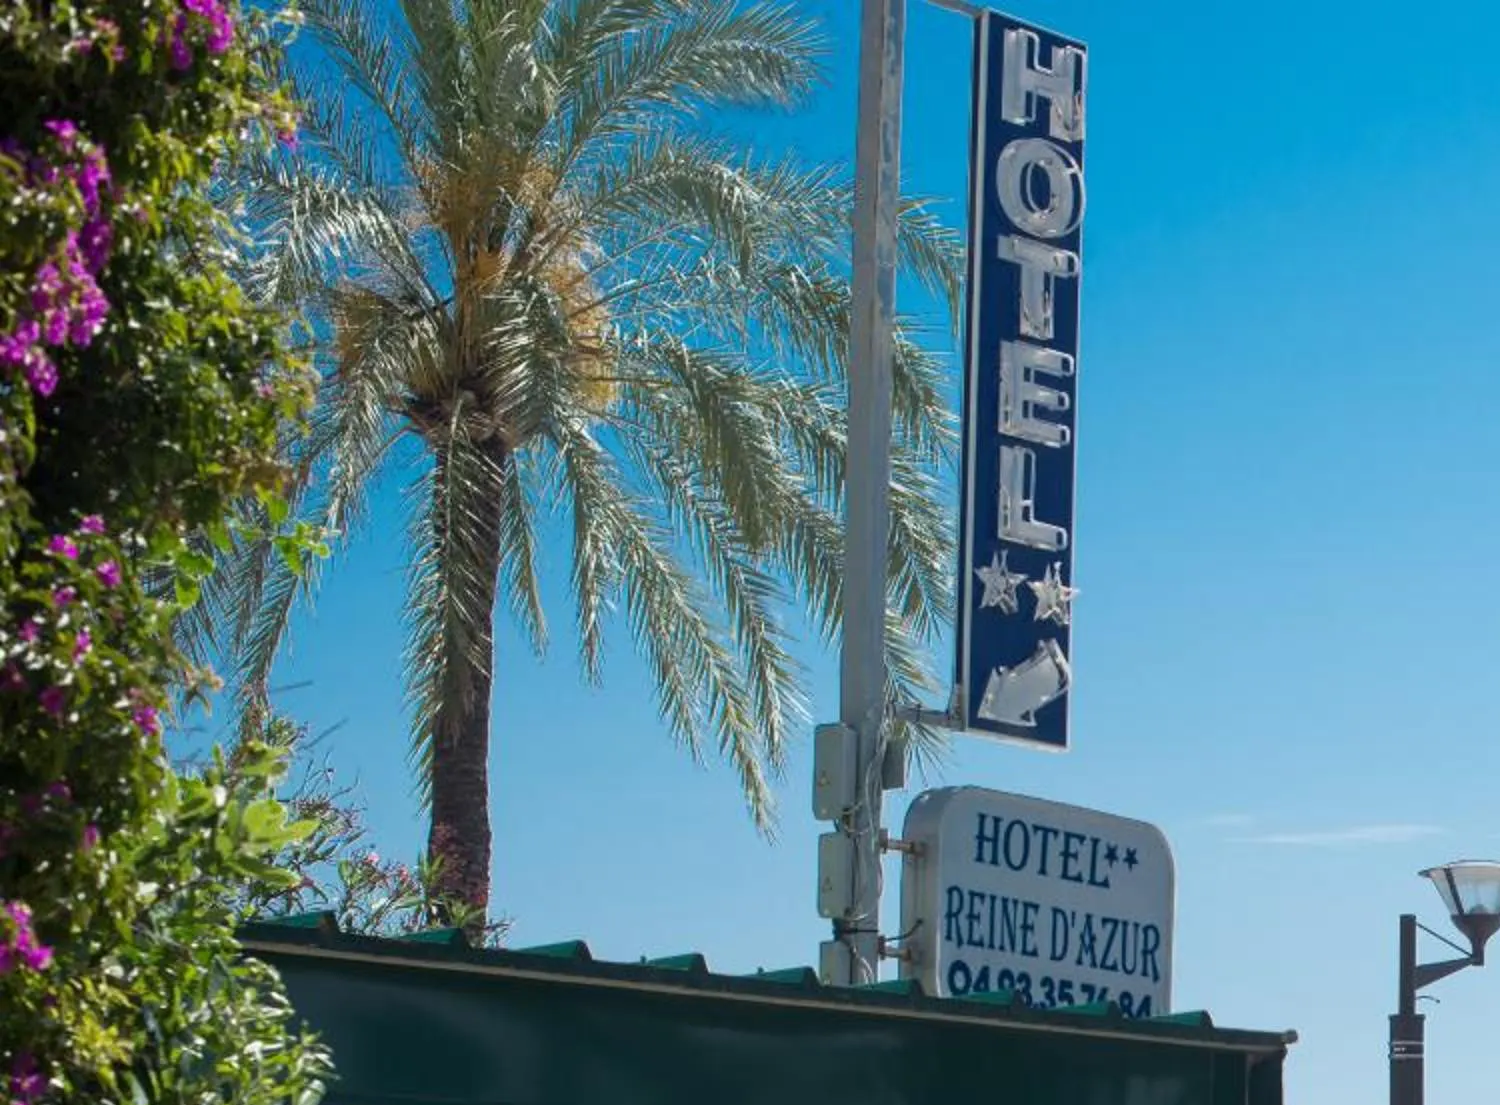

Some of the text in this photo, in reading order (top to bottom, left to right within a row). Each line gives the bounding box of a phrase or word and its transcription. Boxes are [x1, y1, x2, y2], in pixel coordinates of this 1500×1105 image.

[996, 27, 1087, 553] HOTEL
[974, 812, 1111, 889] HOTEL
[944, 884, 1162, 984] REINE D'AZUR
